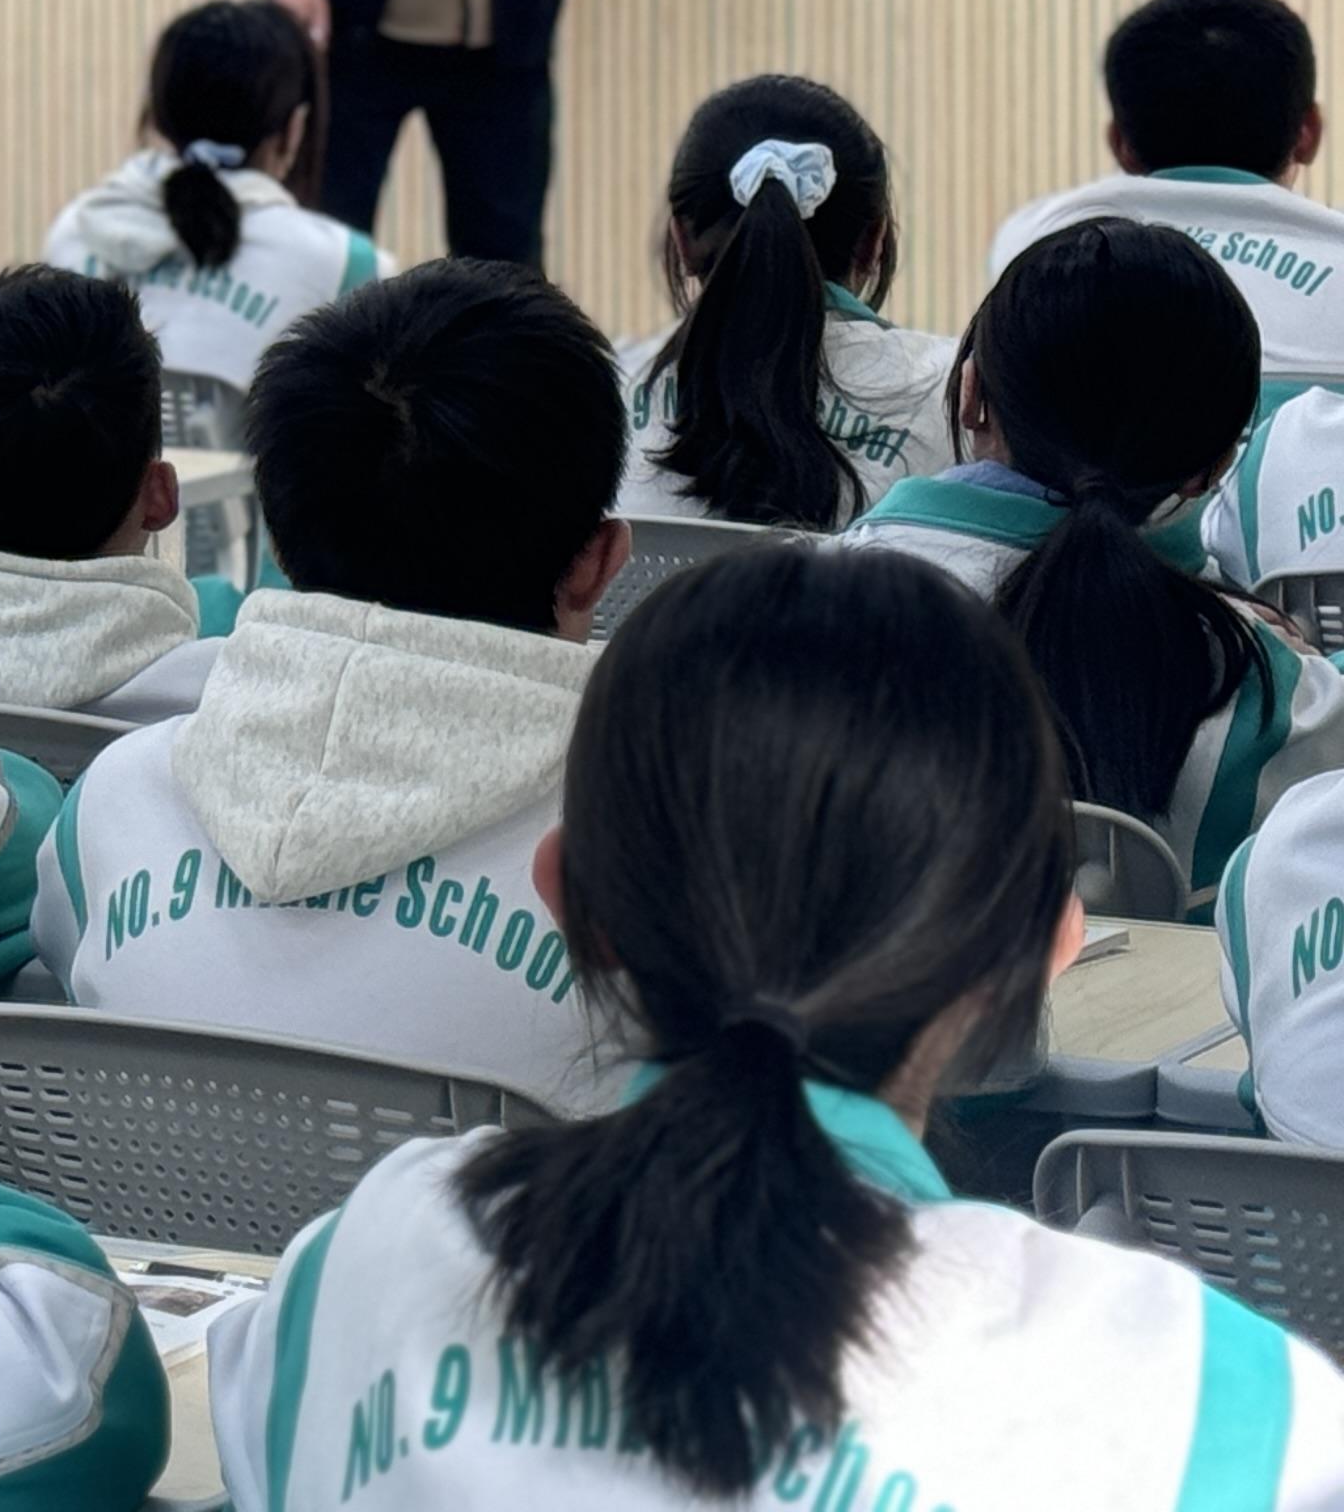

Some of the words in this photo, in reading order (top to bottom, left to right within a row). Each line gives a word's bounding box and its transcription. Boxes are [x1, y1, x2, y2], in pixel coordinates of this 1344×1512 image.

[1220, 231, 1334, 296] School
[105, 869, 160, 962] NO.
[169, 848, 203, 921] 9
[341, 1368, 410, 1505] NO.
[423, 1342, 472, 1452] 9
